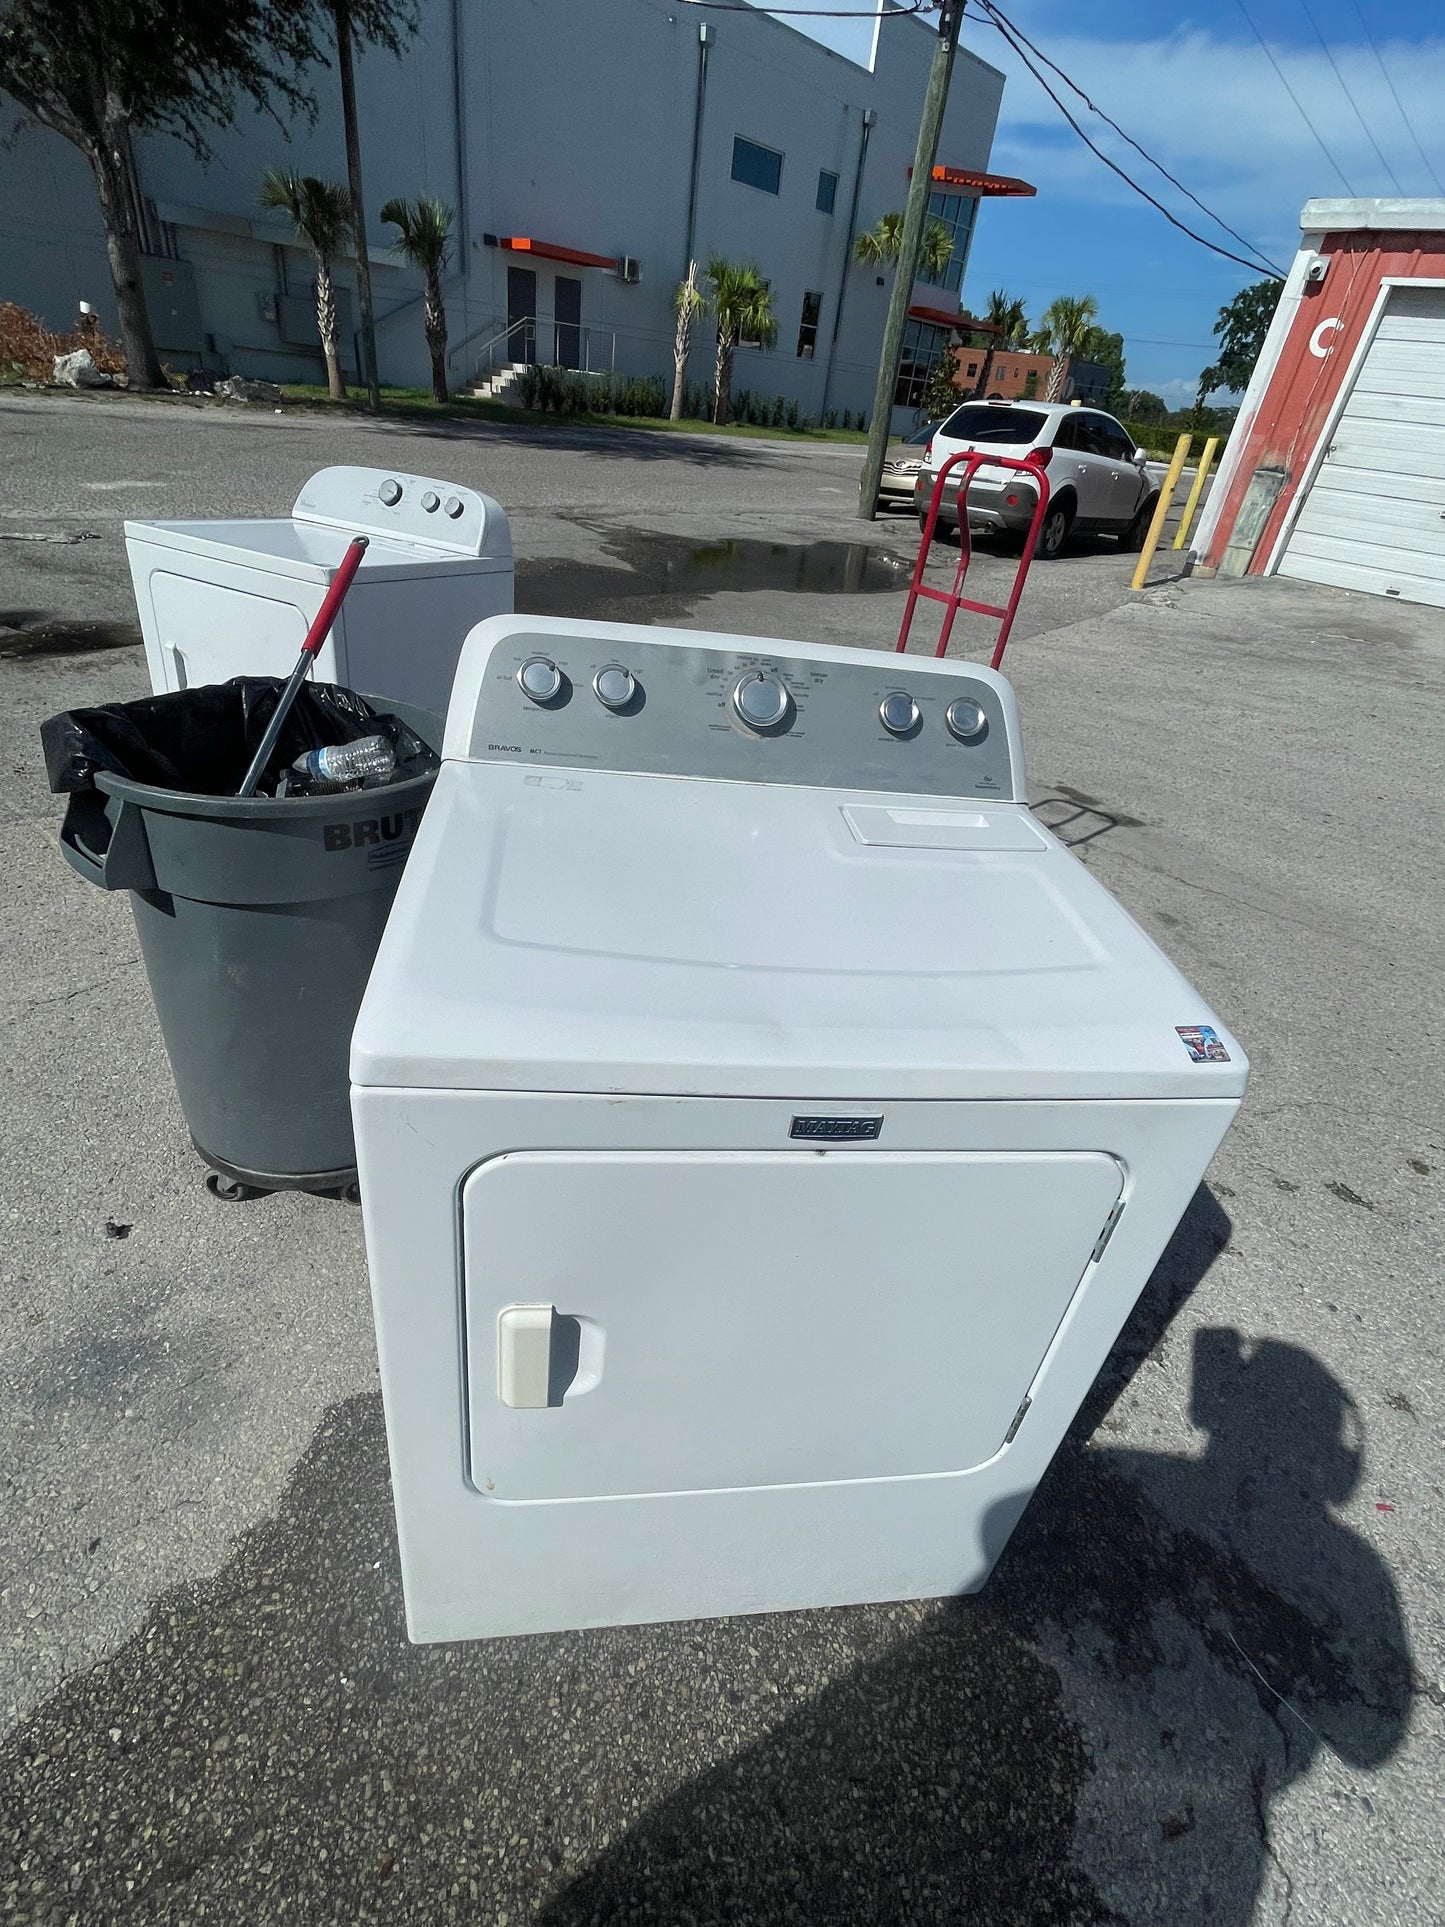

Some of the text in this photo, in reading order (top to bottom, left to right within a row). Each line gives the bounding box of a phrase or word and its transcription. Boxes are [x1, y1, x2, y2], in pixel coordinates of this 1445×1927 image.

[1309, 317, 1345, 358] C
[488, 744, 522, 753] BRAVOS
[793, 1119, 879, 1135] MAYTAG
